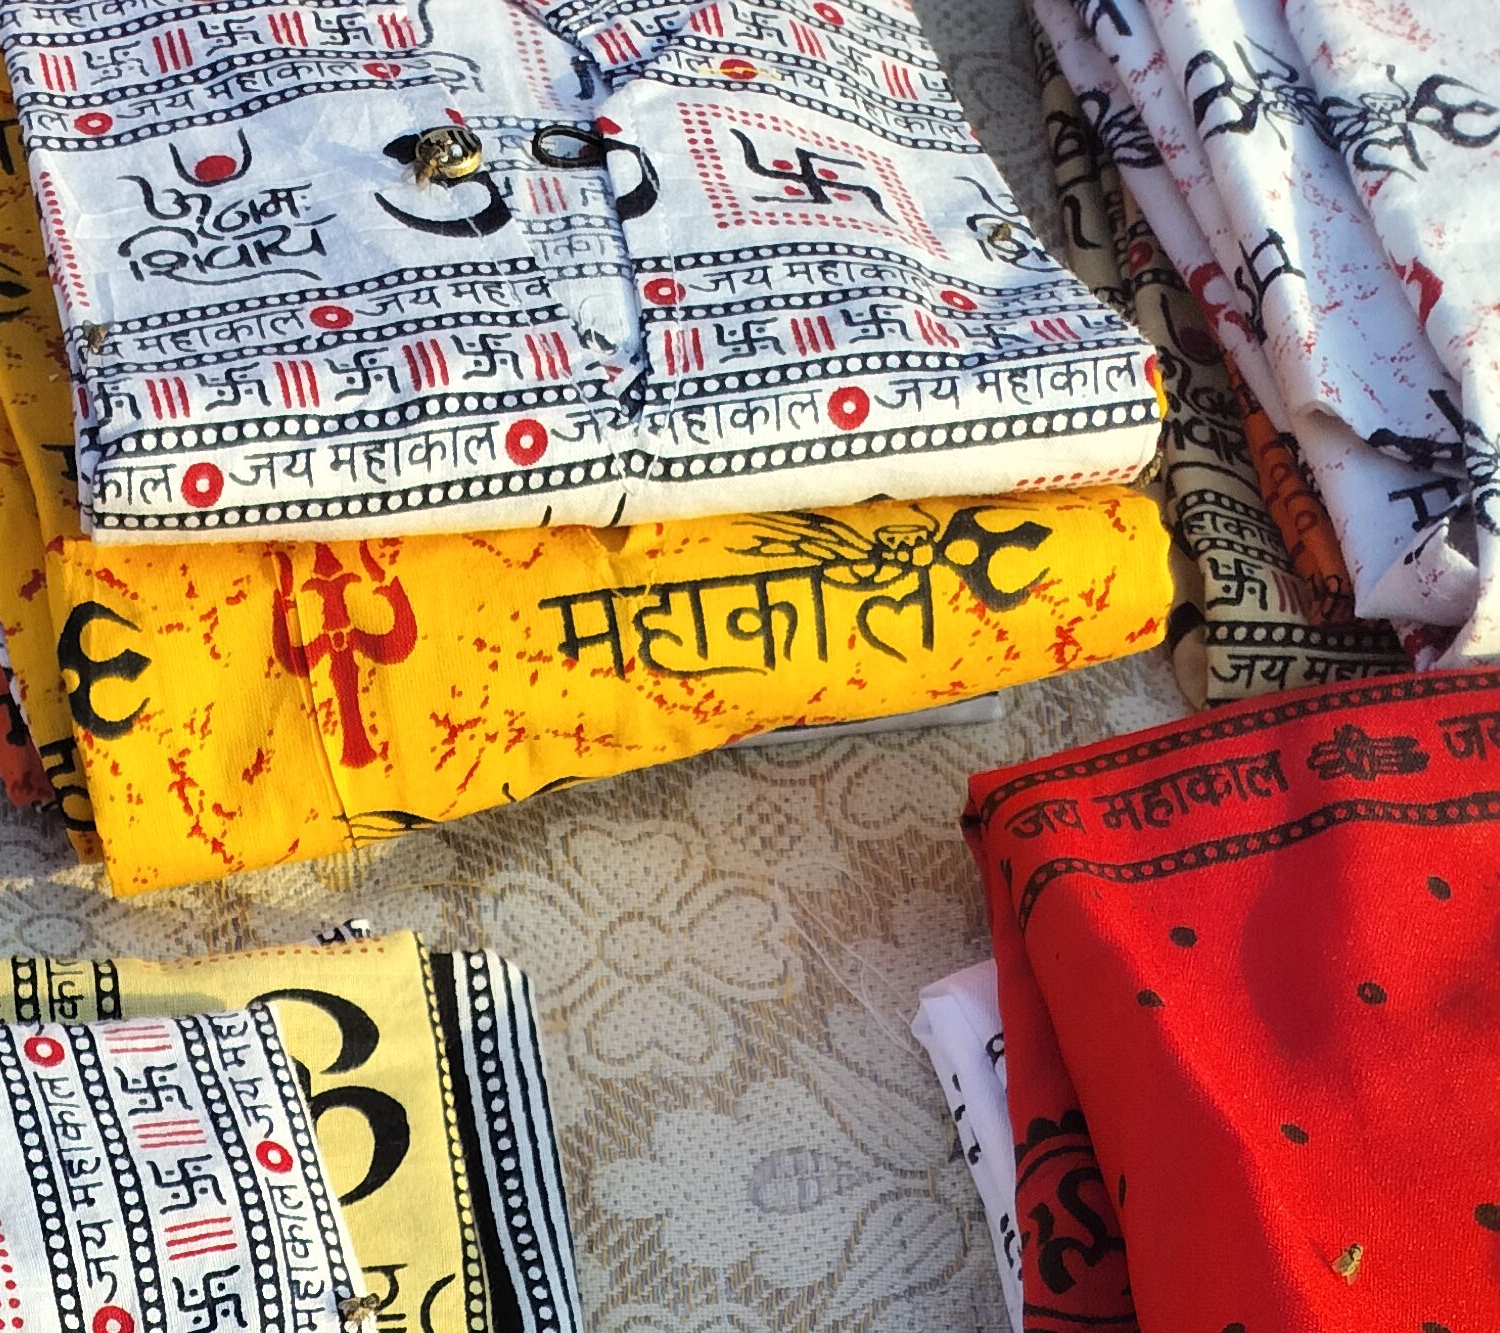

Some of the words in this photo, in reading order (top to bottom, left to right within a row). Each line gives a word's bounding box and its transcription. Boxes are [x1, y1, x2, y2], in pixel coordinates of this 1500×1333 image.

[203, 61, 358, 101] महाकाल
[229, 444, 316, 490] जय
[328, 417, 499, 484] महाकाल
[644, 386, 825, 446] महाकाल
[874, 374, 961, 413] जय
[974, 349, 1142, 405] महाकाल
[538, 560, 935, 680] महाकाल
[1098, 749, 1290, 834] महाकाल
